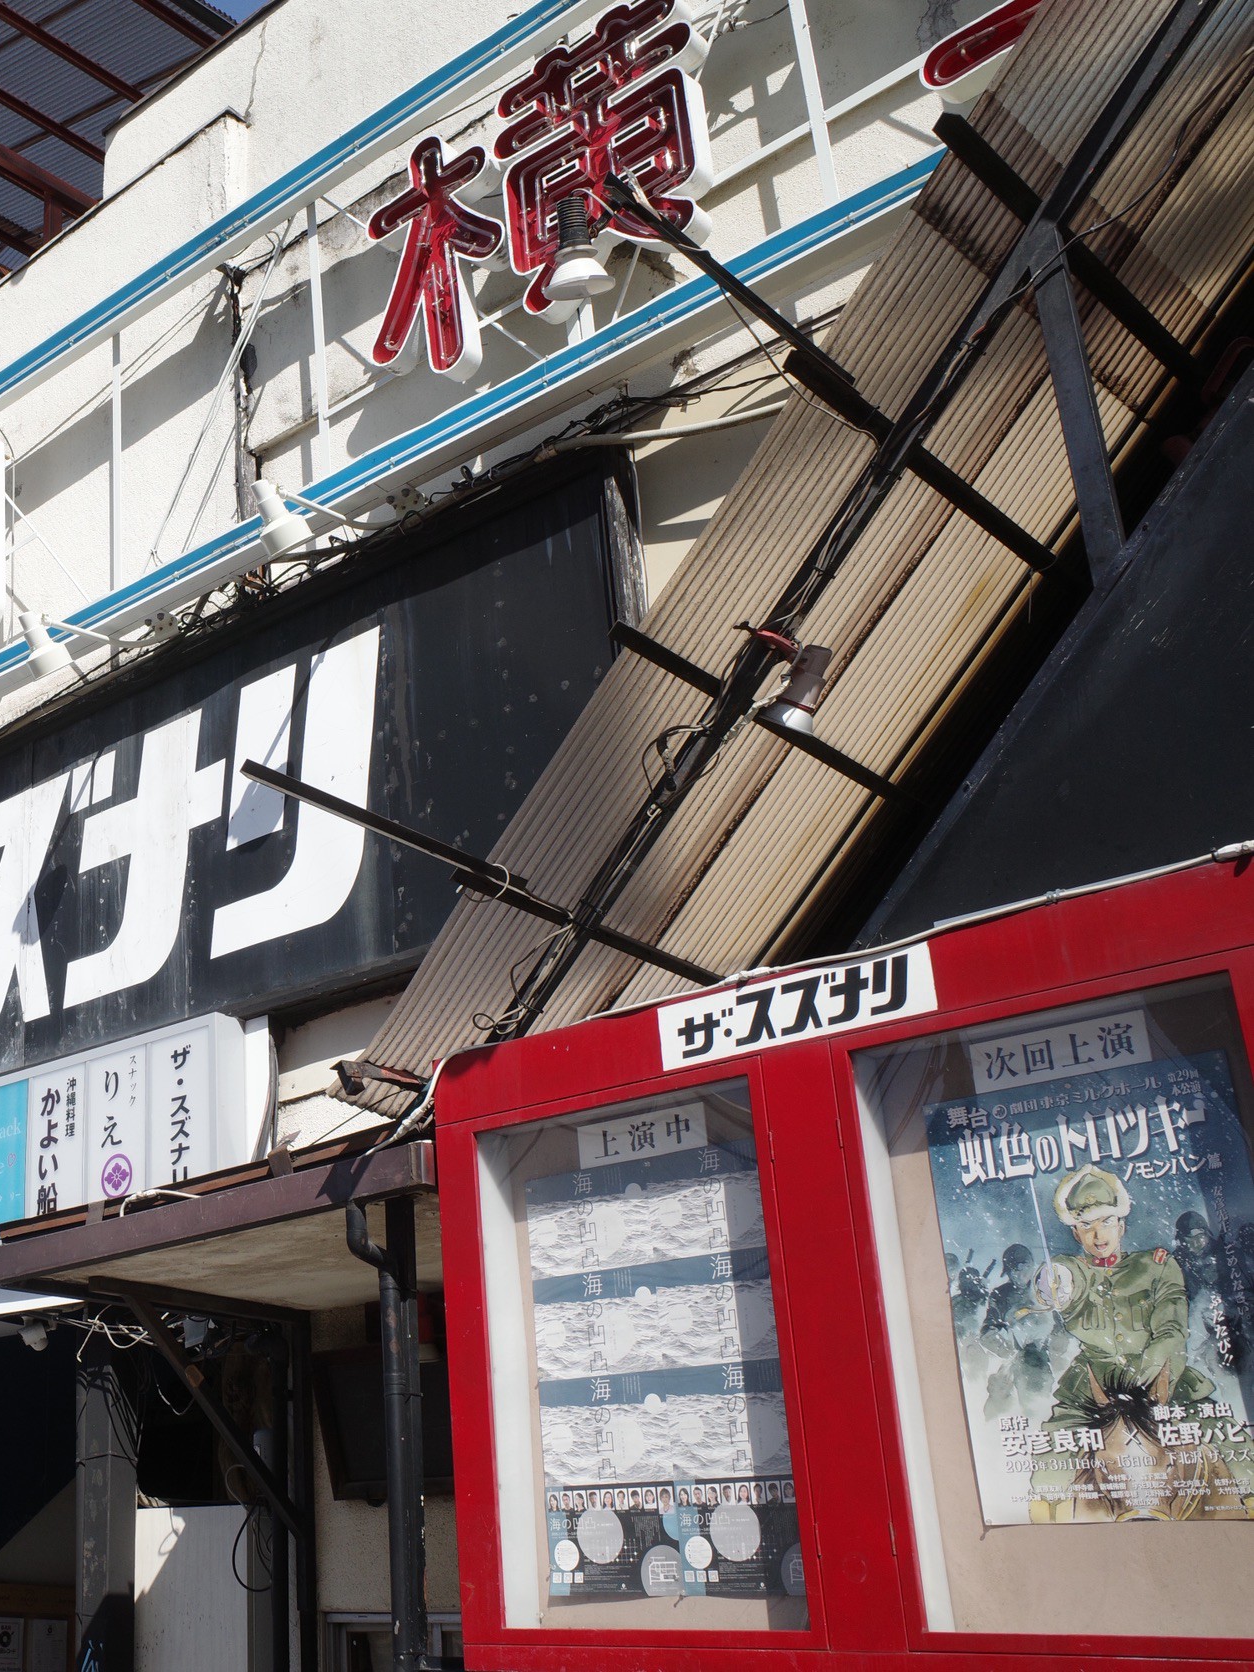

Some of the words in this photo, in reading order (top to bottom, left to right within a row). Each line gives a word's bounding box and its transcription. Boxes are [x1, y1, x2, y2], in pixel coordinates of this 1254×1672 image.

[677, 953, 908, 1059] ザ・スズナリ
[985, 1022, 1135, 1081] 次回上演
[128, 1055, 137, 1107] スナック
[64, 1077, 77, 1137] 沖縄料理
[101, 1070, 122, 1148] りえ
[947, 1106, 988, 1129] 舞台
[37, 1088, 61, 1215] かよい船
[595, 1114, 690, 1159] 上演中
[999, 1416, 1029, 1431] 原作
[1154, 1402, 1234, 1421] 脚本・演出
[1002, 1428, 1105, 1457] 安彦良和
[1165, 1450, 1203, 1465] 下北沢
[1209, 1447, 1254, 1463] ザ・スズ
